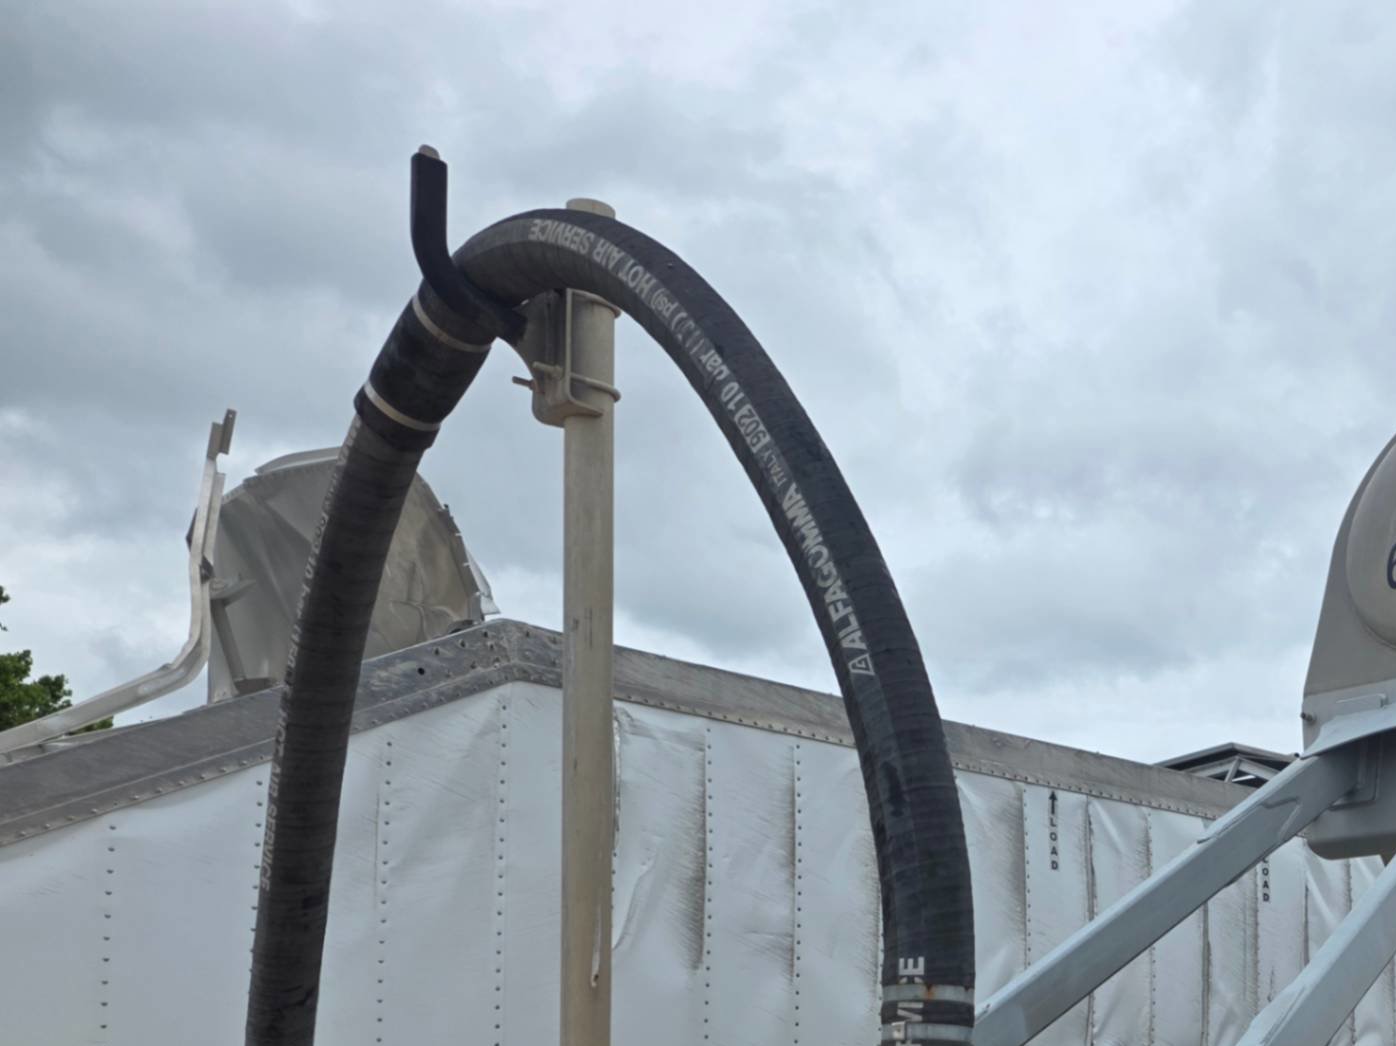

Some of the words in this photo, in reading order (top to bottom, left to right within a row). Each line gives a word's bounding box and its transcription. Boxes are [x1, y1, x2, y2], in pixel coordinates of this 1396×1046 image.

[528, 219, 595, 255] SERVICE
[592, 238, 626, 270] AIR
[618, 258, 656, 298] HOT
[721, 382, 744, 410] 10
[736, 405, 769, 450] 902
[764, 450, 787, 487] ITALY
[782, 483, 867, 650] ALFAGOMMA
[1049, 817, 1058, 870] LOAD
